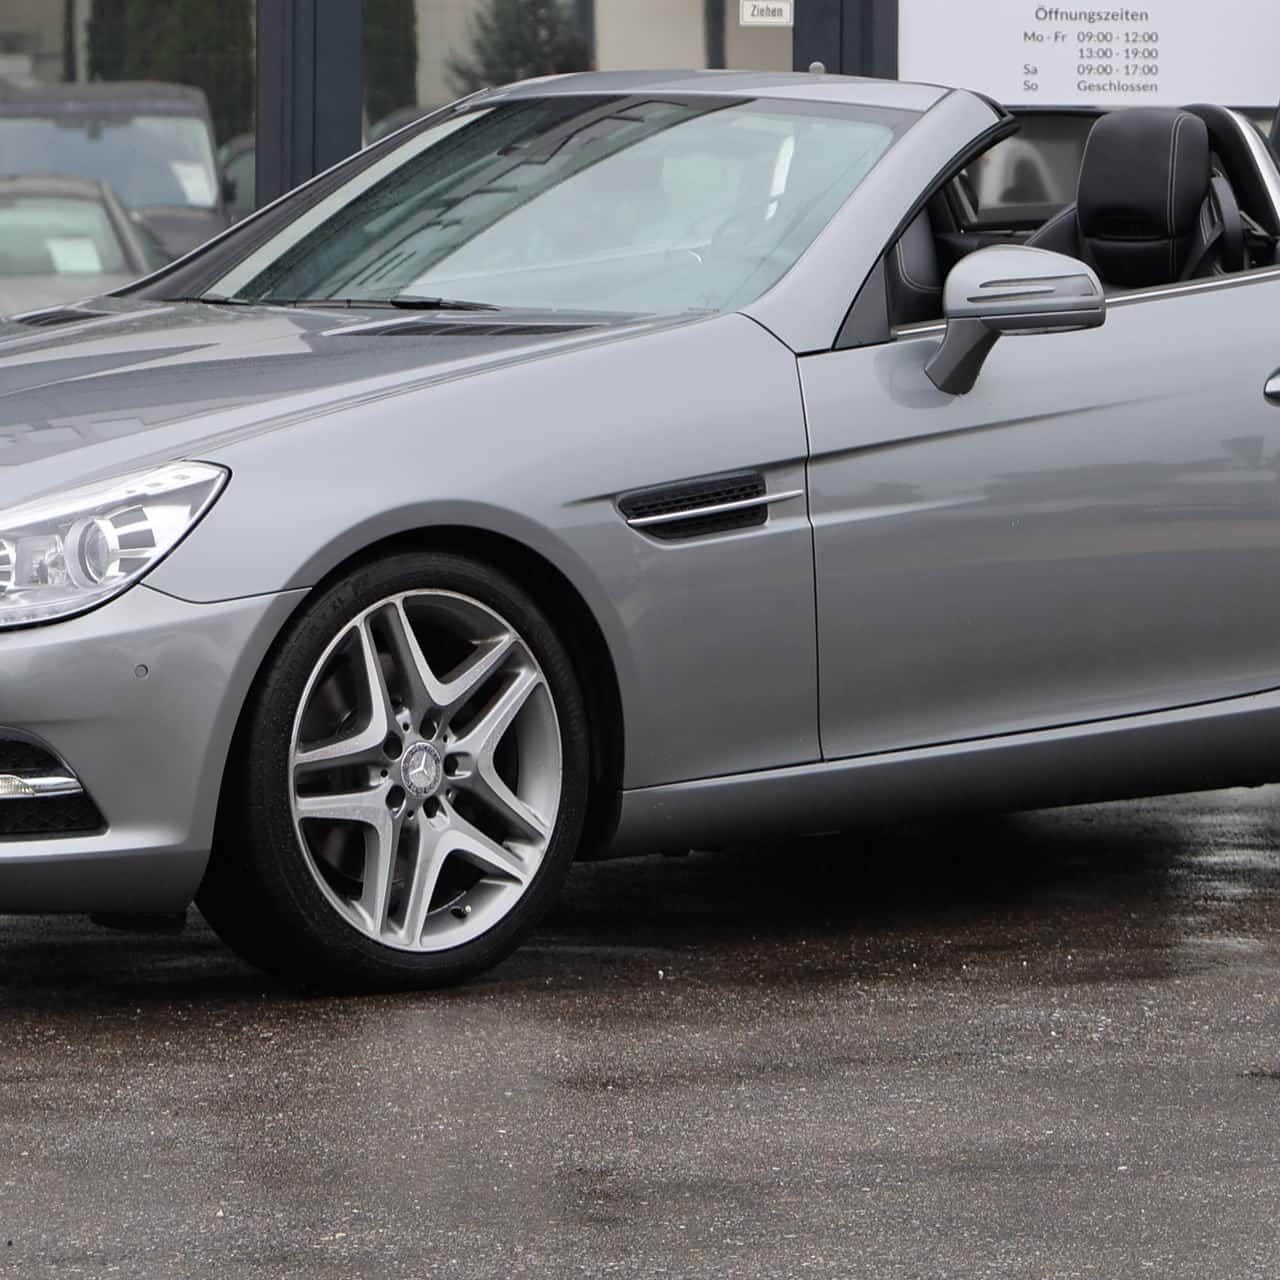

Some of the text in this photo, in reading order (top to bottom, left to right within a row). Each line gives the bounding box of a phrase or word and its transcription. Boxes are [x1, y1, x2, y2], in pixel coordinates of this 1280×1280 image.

[750, 4, 784, 17] Ziehen
[1034, 5, 1149, 24] Öffnungszeiten
[1023, 31, 1044, 42] Mo
[1053, 31, 1066, 43] Fr
[1076, 31, 1113, 43] 09:00
[1124, 31, 1159, 43] 12:00
[1079, 47, 1113, 59] 13:00
[1124, 47, 1159, 59] 19:00
[1023, 63, 1039, 76] Sa
[1076, 63, 1113, 76] 09:00
[1124, 63, 1159, 76] 17:00
[1023, 79, 1158, 92] So Geschlossen
